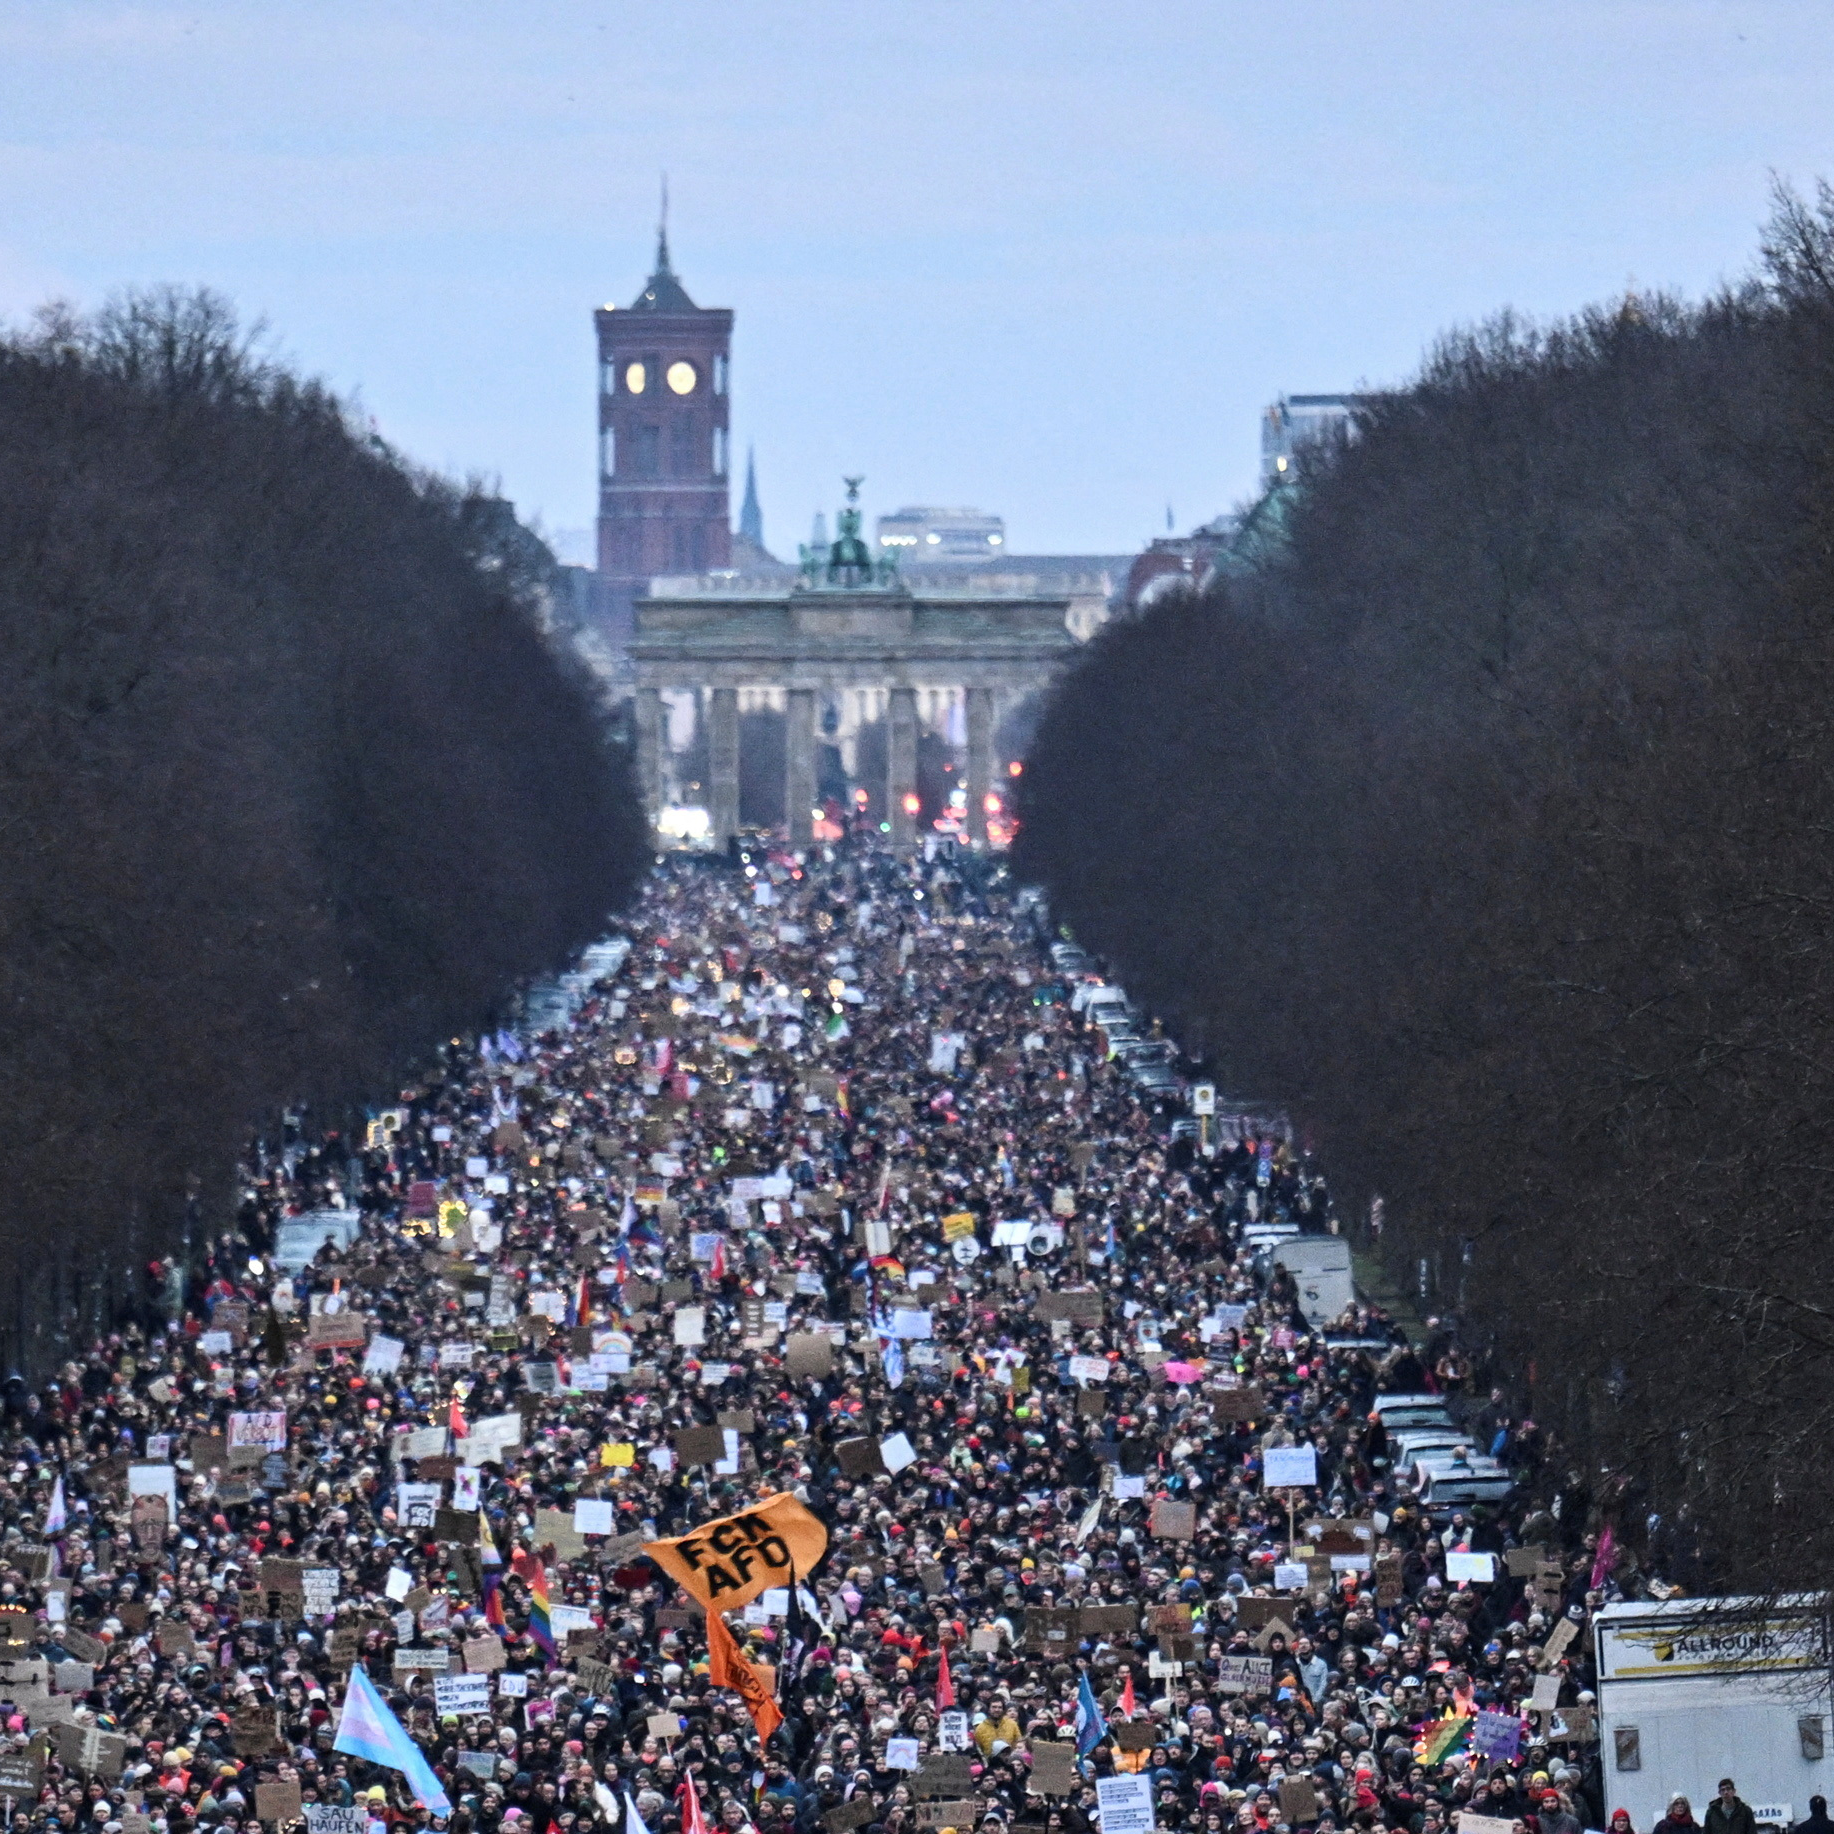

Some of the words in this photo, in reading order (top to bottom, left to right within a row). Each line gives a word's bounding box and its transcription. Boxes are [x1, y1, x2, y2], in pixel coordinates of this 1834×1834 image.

[676, 1510, 777, 1574] FCK
[707, 1536, 793, 1598] AFD
[1677, 1635, 1774, 1652] ALLROUND
[310, 1819, 365, 1834] HAUFEN
